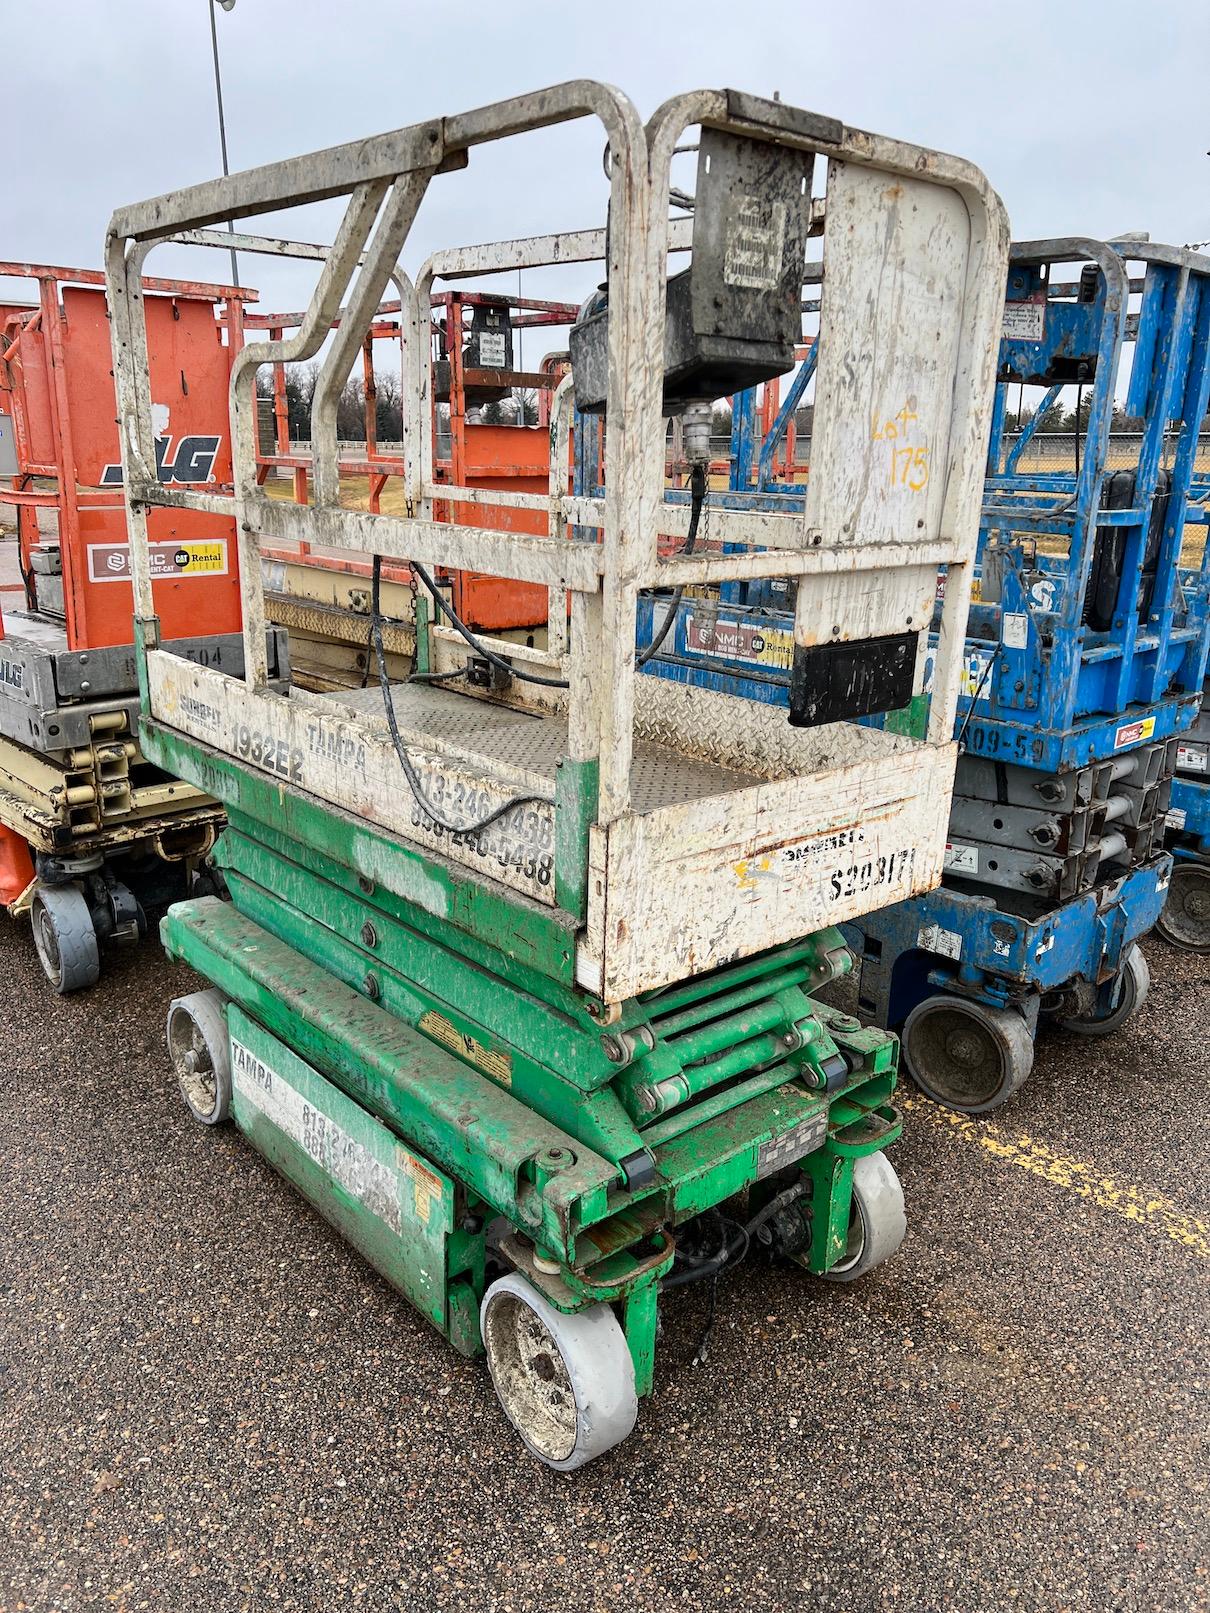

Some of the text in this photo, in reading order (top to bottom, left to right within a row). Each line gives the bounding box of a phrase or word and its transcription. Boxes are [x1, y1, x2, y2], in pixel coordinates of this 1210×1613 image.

[872, 396, 918, 441] Lot
[891, 447, 930, 491] 175
[175, 554, 188, 565] CAT
[192, 553, 221, 562] Rental
[752, 640, 764, 650] CAT
[766, 642, 795, 656] Rental
[231, 722, 304, 785] 1932E2
[307, 723, 366, 770] TAMPA
[232, 1042, 273, 1094] TAMPA
